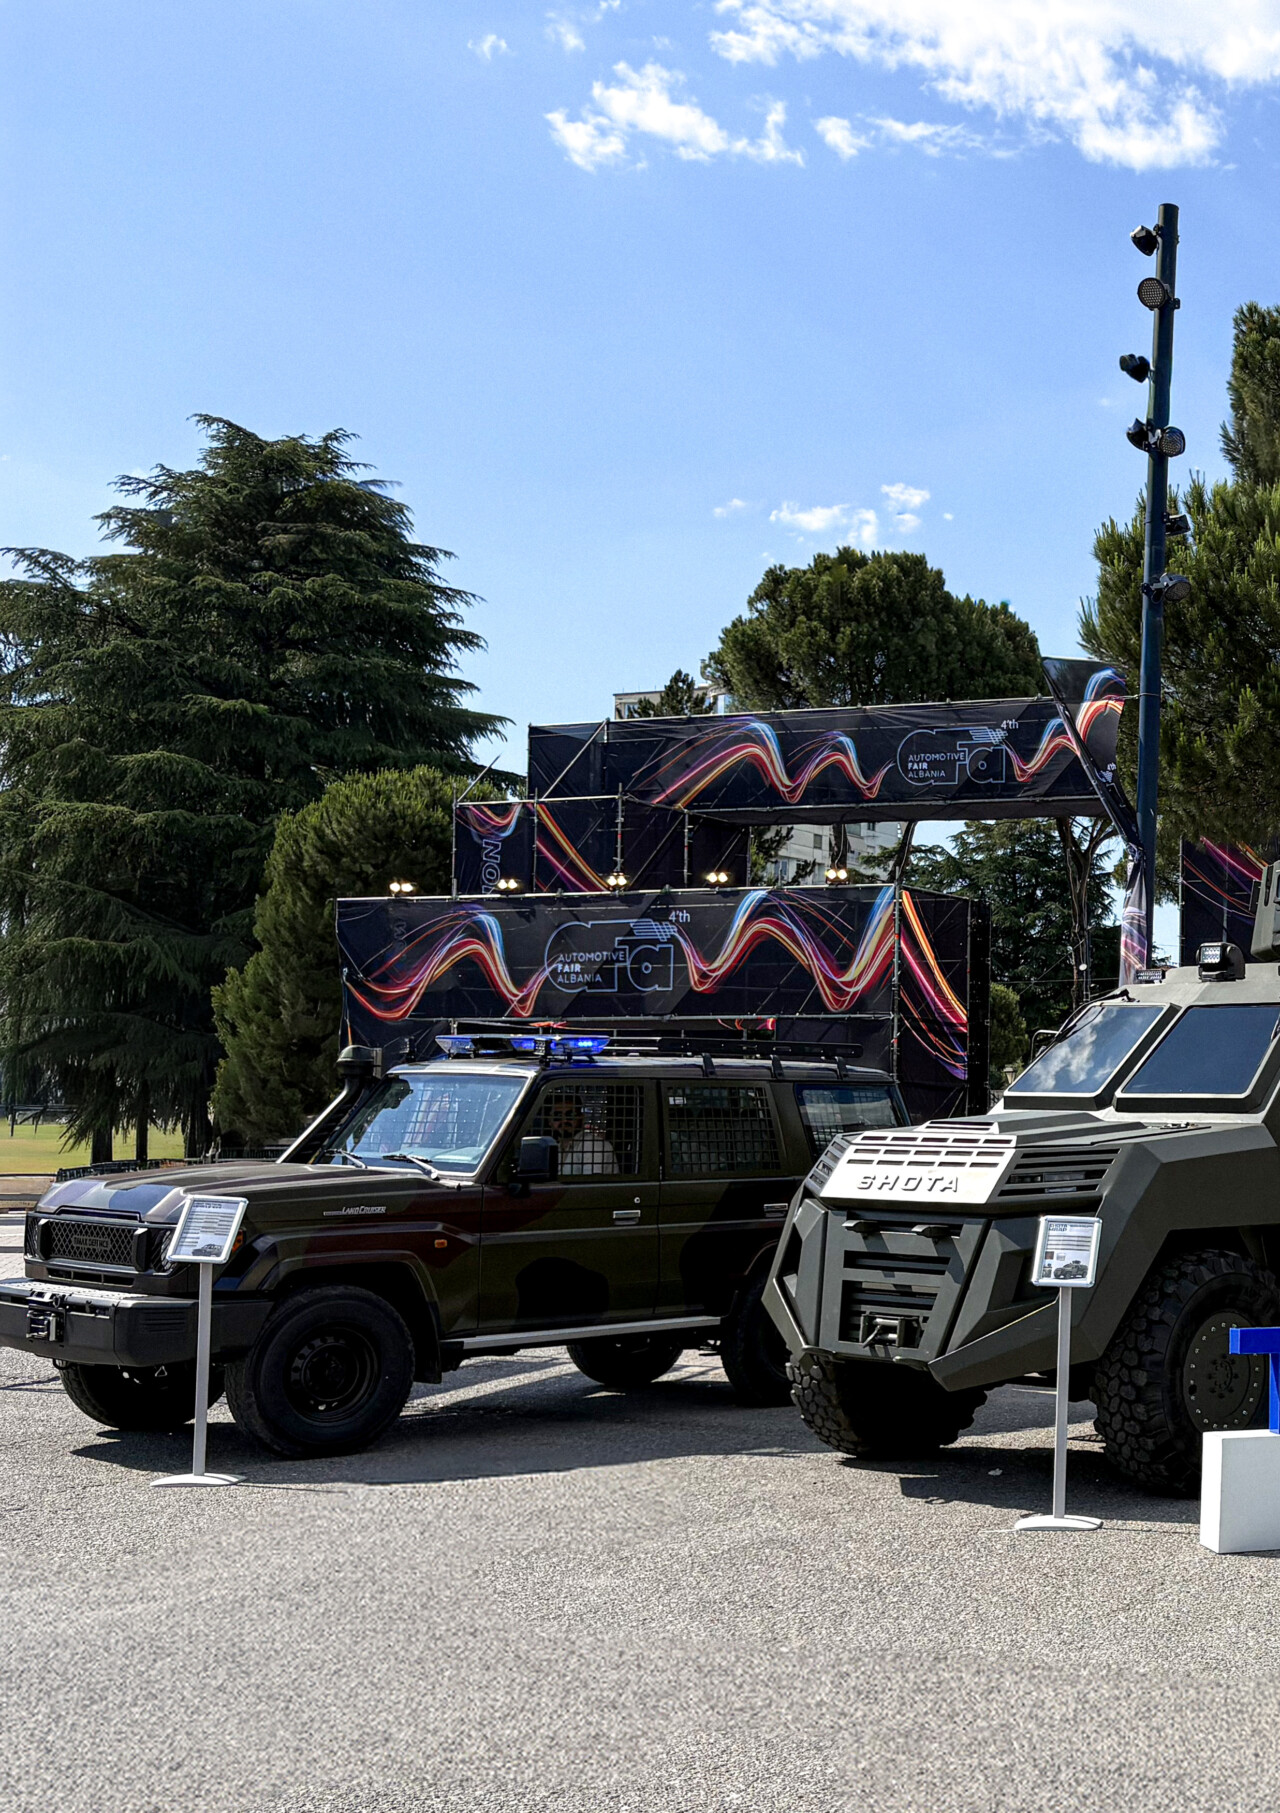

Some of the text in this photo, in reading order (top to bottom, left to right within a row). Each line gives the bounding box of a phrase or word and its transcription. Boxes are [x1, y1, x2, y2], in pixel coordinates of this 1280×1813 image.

[908, 752, 966, 762] AUTOMOTIVE
[908, 762, 928, 770] FAIR
[908, 770, 946, 779] ALBANIA
[558, 951, 625, 963] AUTOMOTIVE
[557, 963, 581, 973] FAIR
[557, 973, 602, 984] ALBANIA
[857, 1175, 959, 1193] SHOTA
